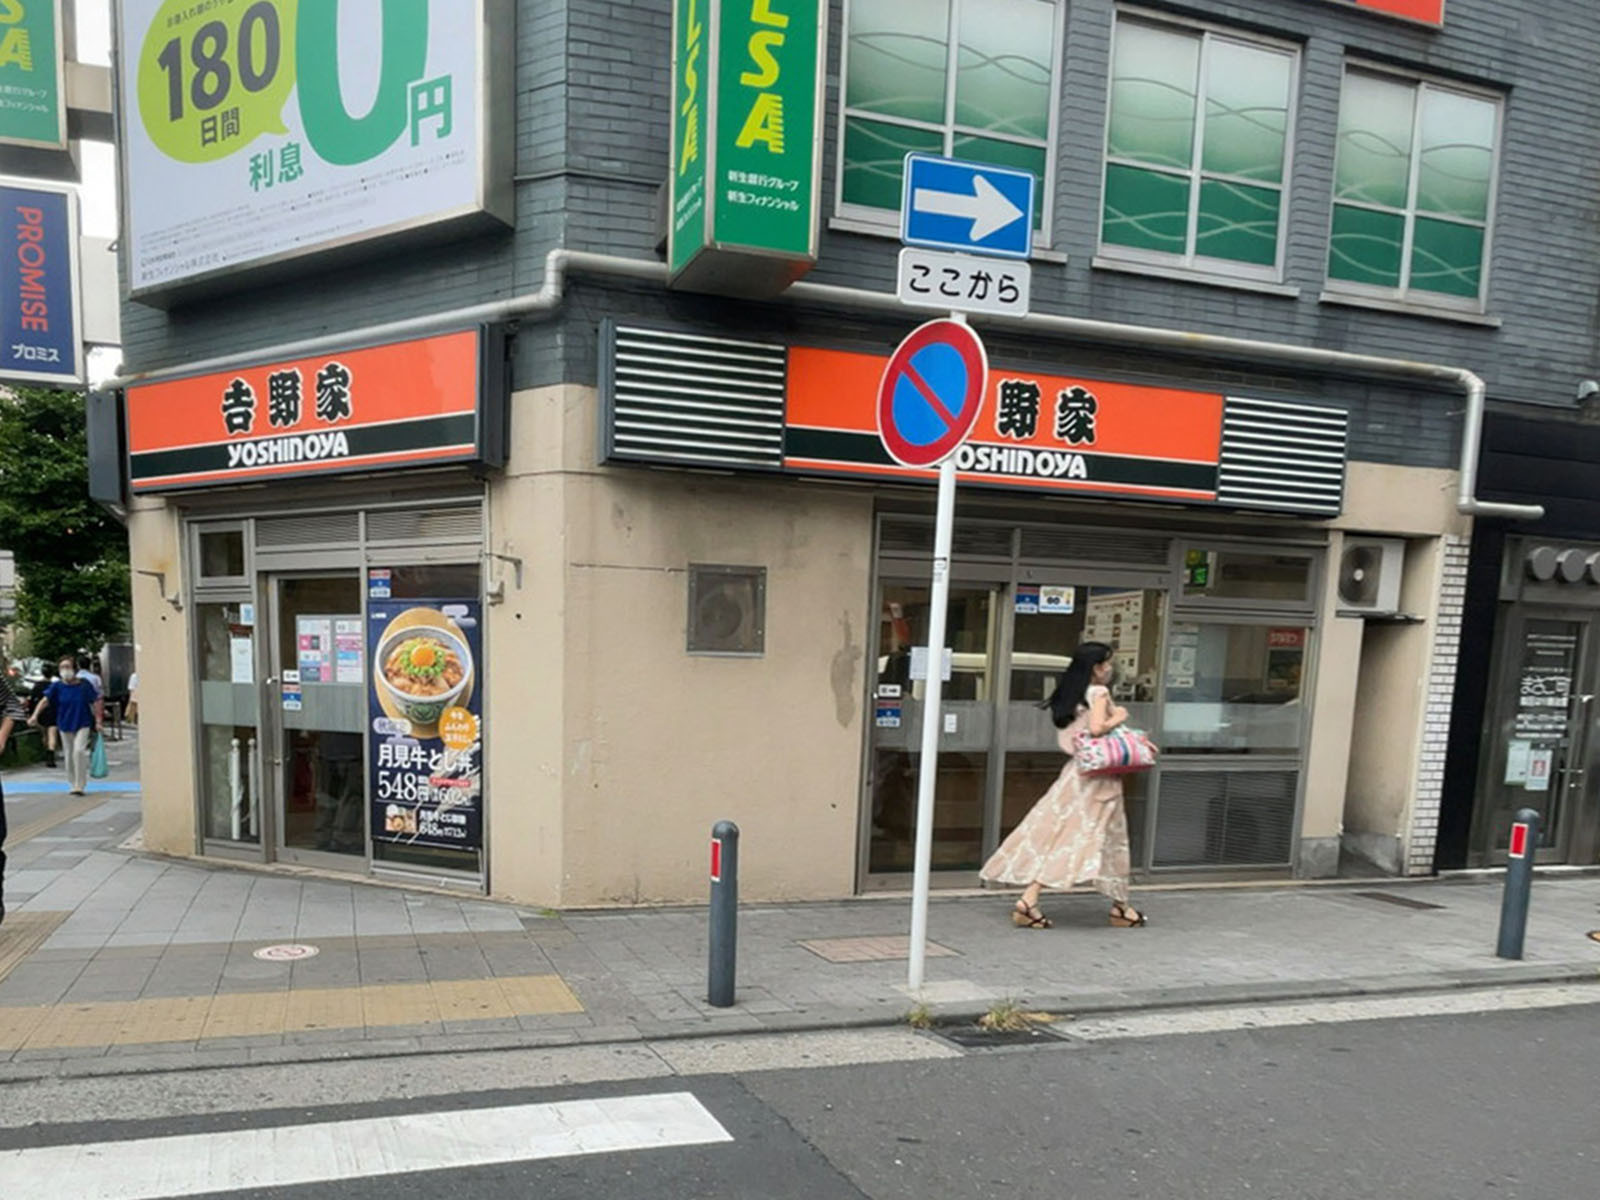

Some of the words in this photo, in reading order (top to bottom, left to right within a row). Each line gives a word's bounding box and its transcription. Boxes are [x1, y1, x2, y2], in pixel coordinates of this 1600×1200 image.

[157, 0, 281, 122] 180
[200, 107, 241, 147] 日間
[410, 75, 452, 147] 円
[249, 142, 304, 192] 利息
[16, 206, 48, 332] PROMISE
[909, 263, 1020, 303] ここから
[12, 344, 60, 363] プロミス
[220, 361, 353, 435] 吉野家
[997, 379, 1098, 446] 野家
[227, 432, 349, 468] YOSHINOYA
[955, 444, 1088, 478] OSHINOYA
